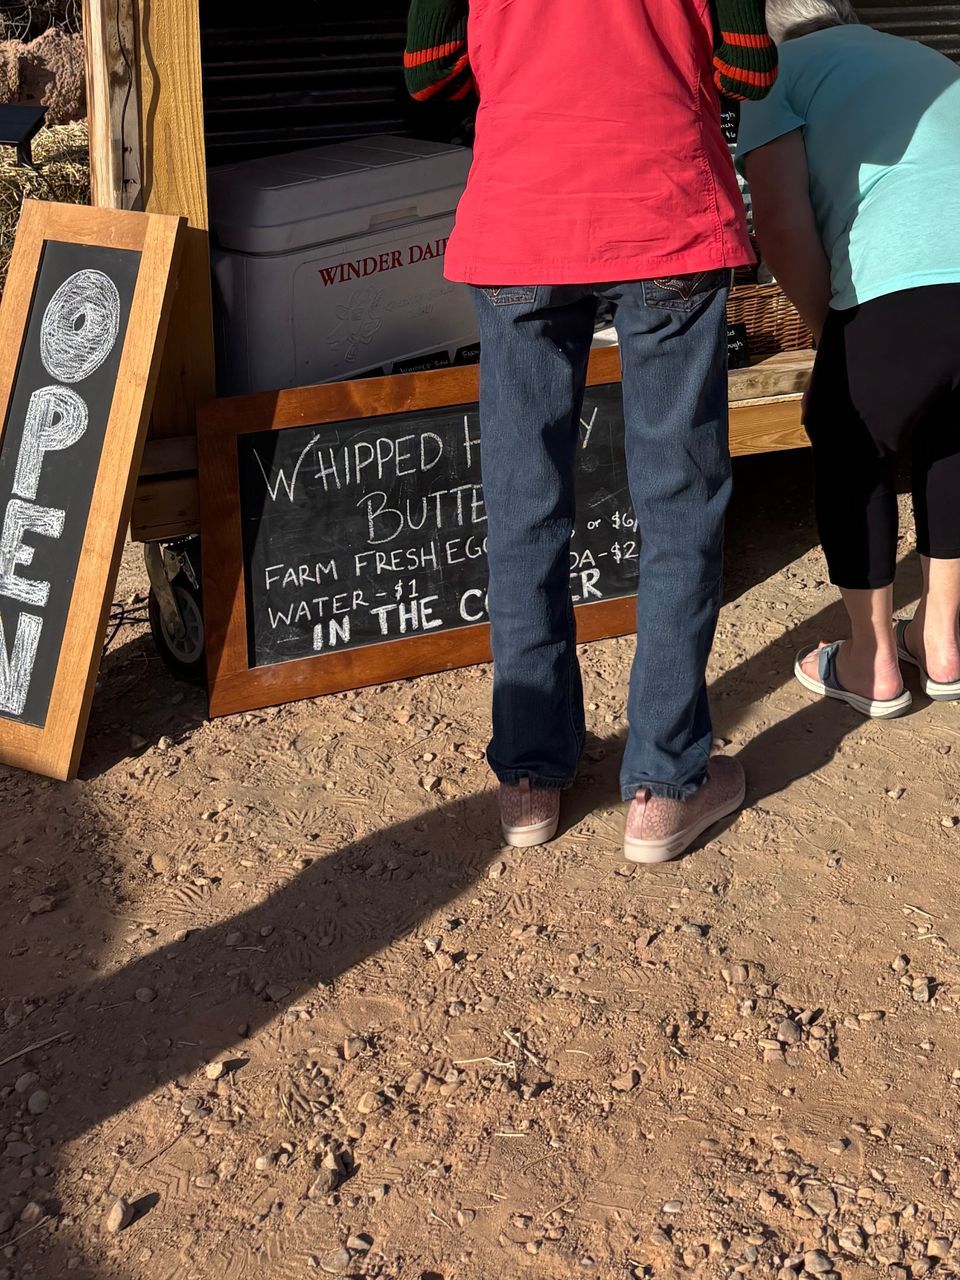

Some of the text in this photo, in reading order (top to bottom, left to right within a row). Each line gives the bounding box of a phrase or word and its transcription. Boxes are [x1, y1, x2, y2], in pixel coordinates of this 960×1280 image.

[318, 236, 450, 287] WINDER DAI
[0, 268, 121, 716] OPEN
[252, 431, 444, 503] WHIPPED
[356, 483, 488, 545] BUTTE
[265, 559, 338, 590] FARM
[354, 541, 437, 577] FRESH
[445, 535, 489, 565] EG
[268, 590, 370, 629] WATER
[394, 578, 419, 601] $1
[312, 614, 351, 651] IN
[369, 595, 443, 635] THE
